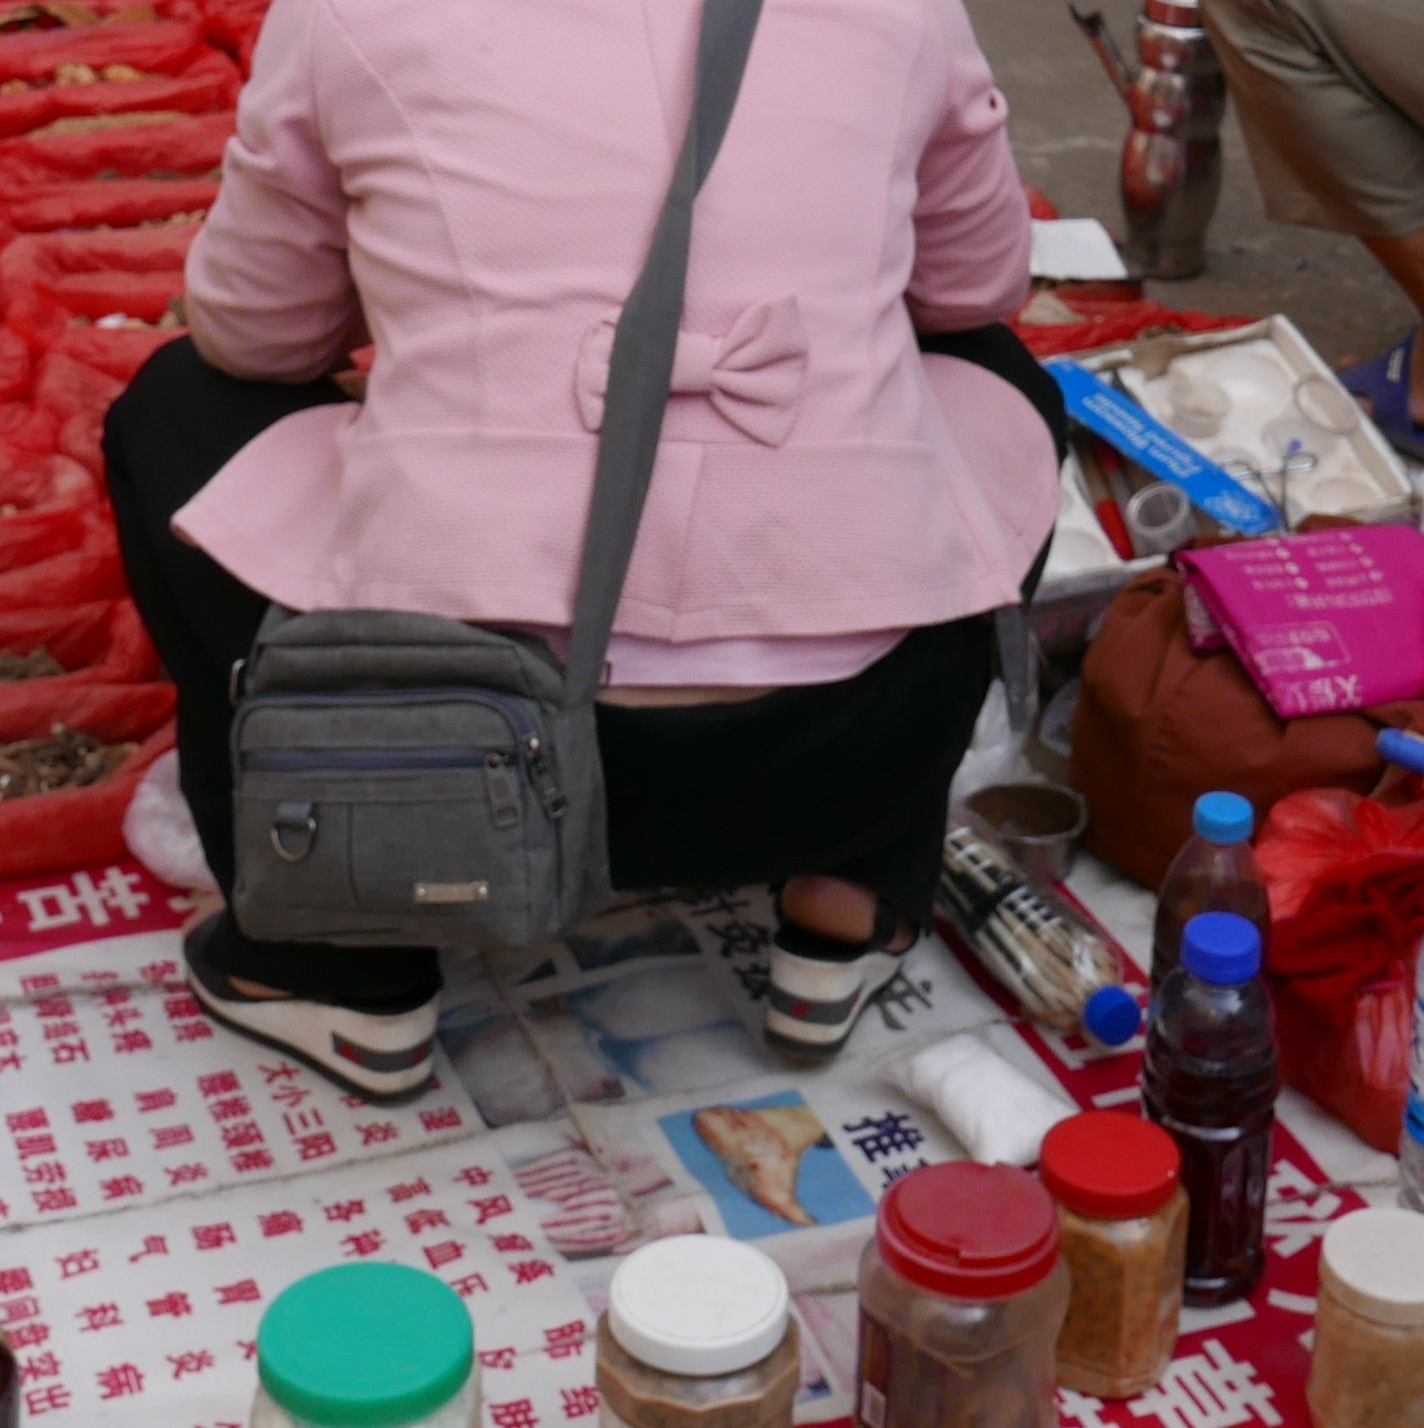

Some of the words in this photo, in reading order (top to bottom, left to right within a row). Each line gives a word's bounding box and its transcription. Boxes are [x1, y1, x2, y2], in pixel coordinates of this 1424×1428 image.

[7, 1108, 77, 1212] 腰肌劳损
[73, 1099, 143, 1200] 糖尿病
[136, 1089, 207, 1185] 肩周炎
[197, 1070, 273, 1172] 腰椎颈椎
[261, 1062, 337, 1162] 大小三阳
[387, 1178, 489, 1296] 高低血压
[452, 1166, 555, 1284] 中风瘫痪
[57, 1249, 144, 1400] 妇科病
[128, 1235, 213, 1379] 气管炎
